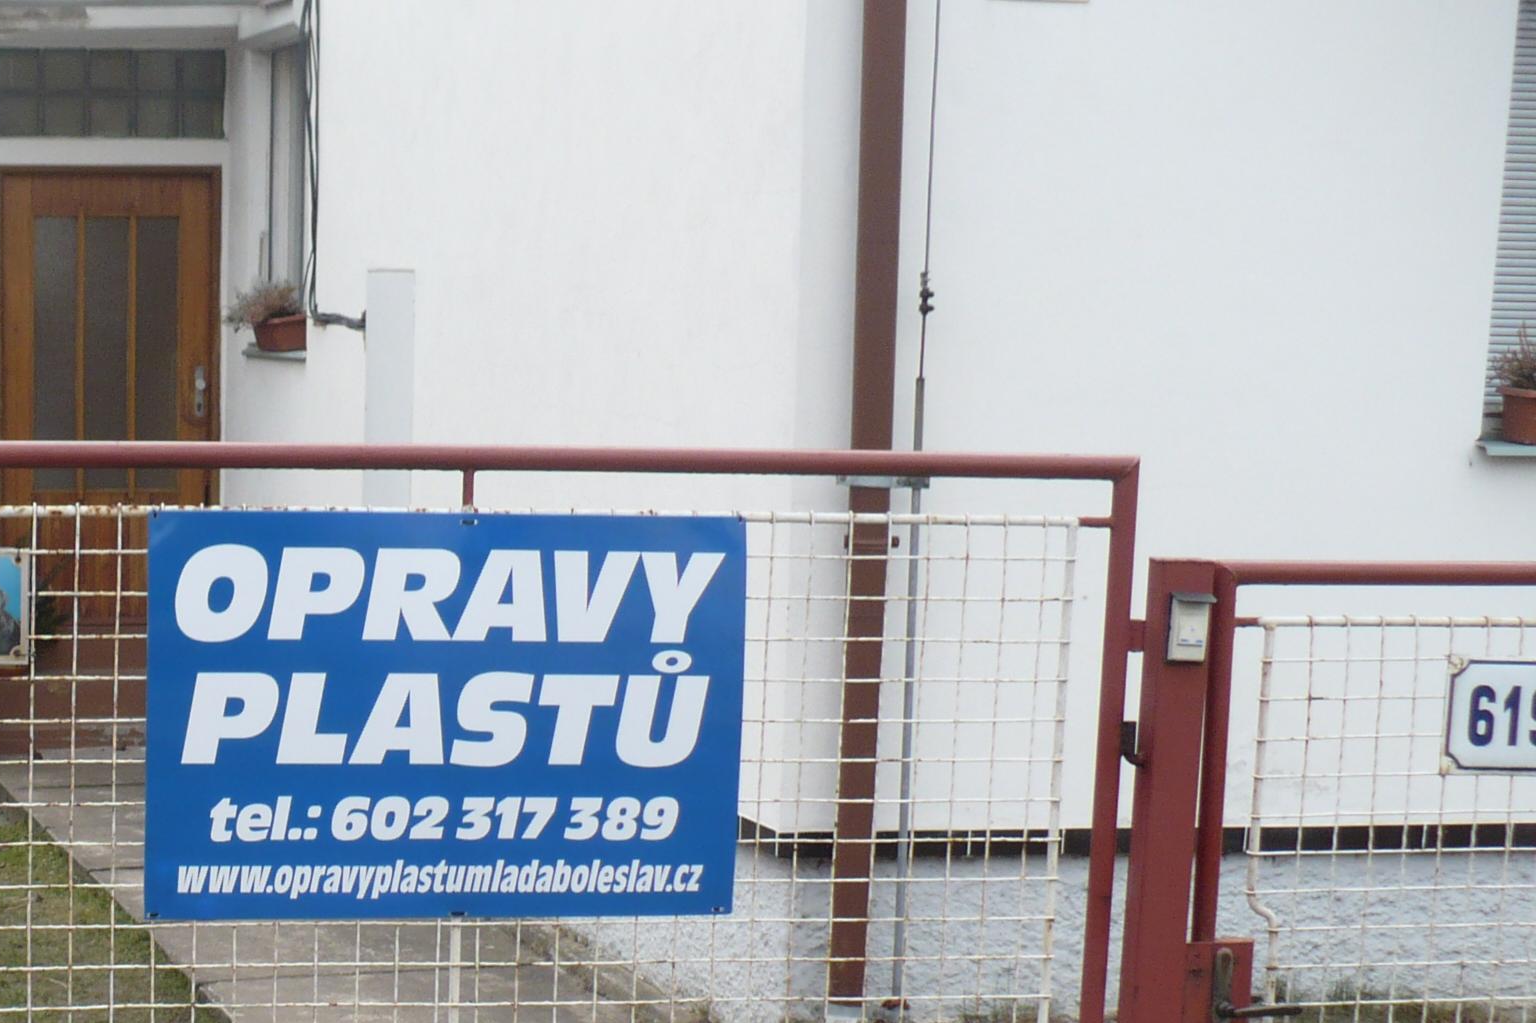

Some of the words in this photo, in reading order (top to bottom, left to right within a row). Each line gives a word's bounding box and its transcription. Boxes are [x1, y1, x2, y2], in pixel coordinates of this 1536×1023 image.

[175, 543, 726, 644] OPRAVY
[180, 650, 710, 768] PLASTŮ
[209, 796, 322, 842] tel.:
[330, 797, 450, 840] 602
[455, 797, 557, 840] 317
[563, 797, 680, 840] 389
[177, 859, 704, 900] www.opravyplastumladaboleslav.cz
